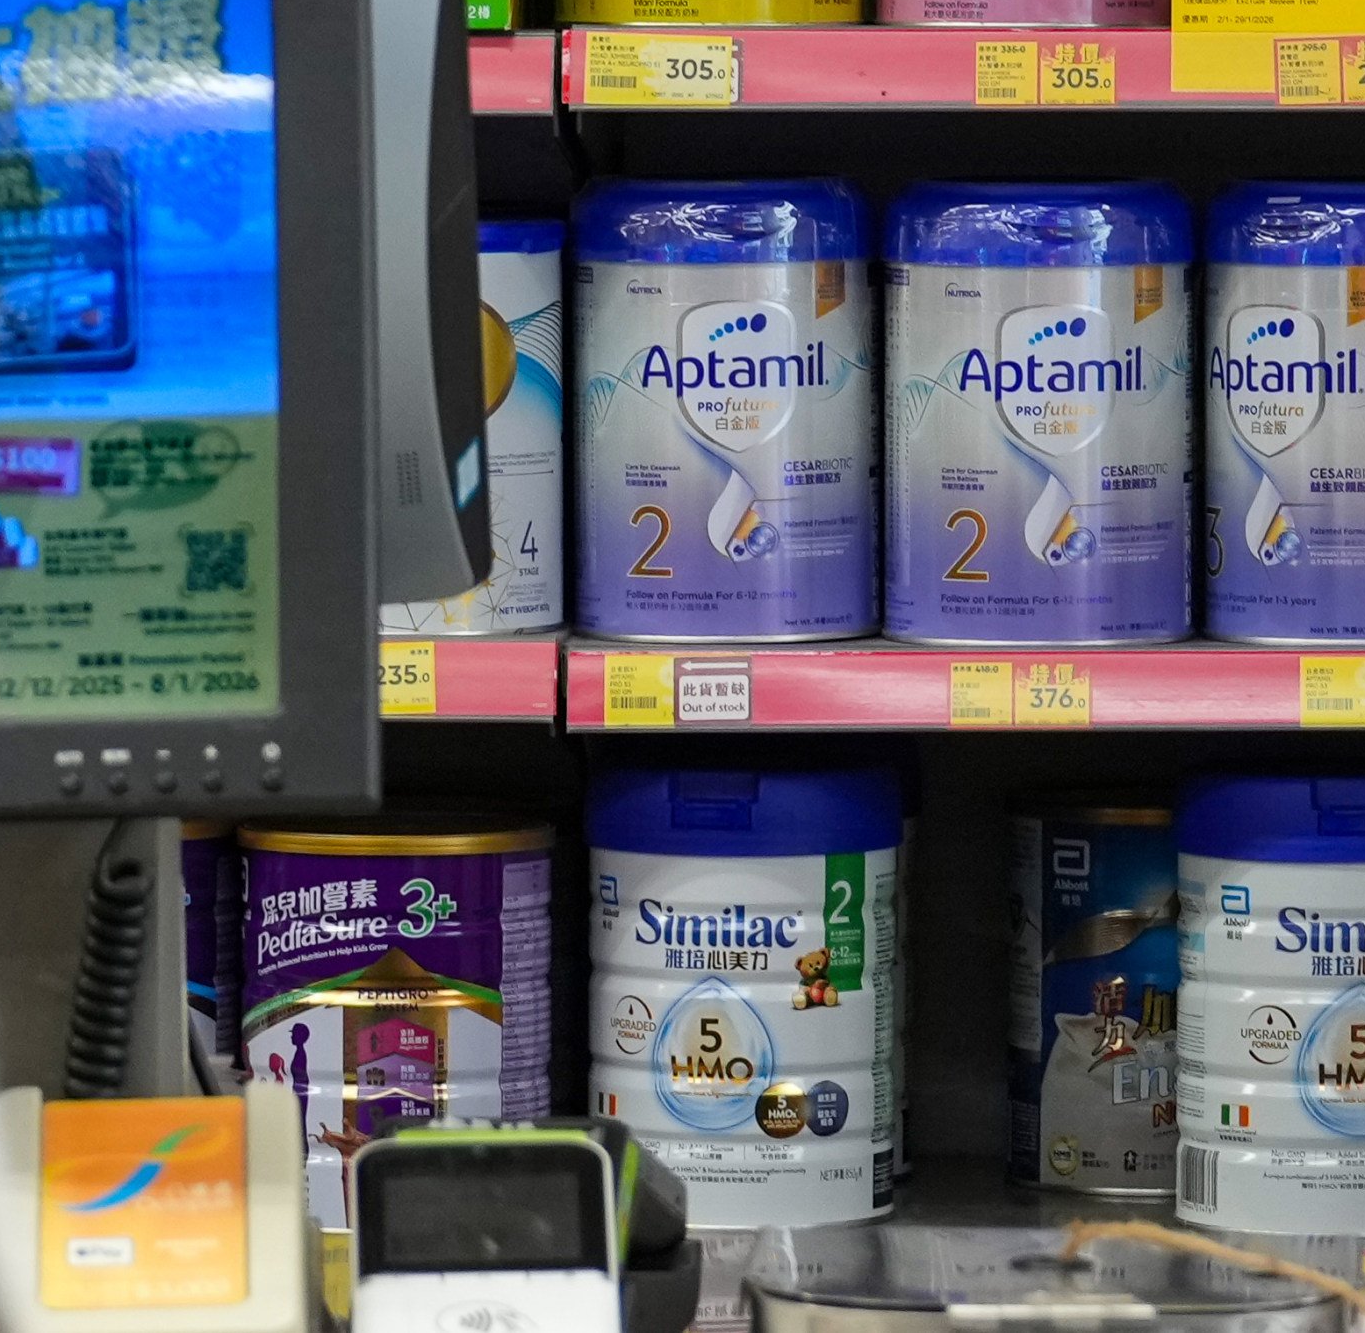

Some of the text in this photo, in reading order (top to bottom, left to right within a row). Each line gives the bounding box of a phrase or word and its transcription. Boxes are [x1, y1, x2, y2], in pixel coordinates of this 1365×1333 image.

[1052, 68, 1111, 89] 305.0
[629, 285, 662, 295] NUTRICIA
[641, 341, 829, 398] Aptamil
[959, 346, 1146, 403] Aptamil
[1210, 346, 1364, 399] Aptamil
[520, 520, 538, 562] 4
[627, 505, 673, 579] 2
[682, 682, 745, 698] 此貨暫缺
[682, 702, 746, 713] Out of stock
[1029, 688, 1086, 709] 376.0
[261, 878, 379, 928] 保兒加營素
[397, 878, 457, 939] 3+
[257, 914, 388, 965] PediaSure
[635, 898, 798, 949] Similac
[337, 946, 352, 957] Help
[353, 944, 368, 954] Kids
[369, 942, 389, 953] Grow
[610, 1017, 656, 1032] UPGRADED
[700, 1018, 723, 1053] 5
[1240, 1028, 1302, 1043] UPGRADED
[671, 1055, 754, 1084] HMO
